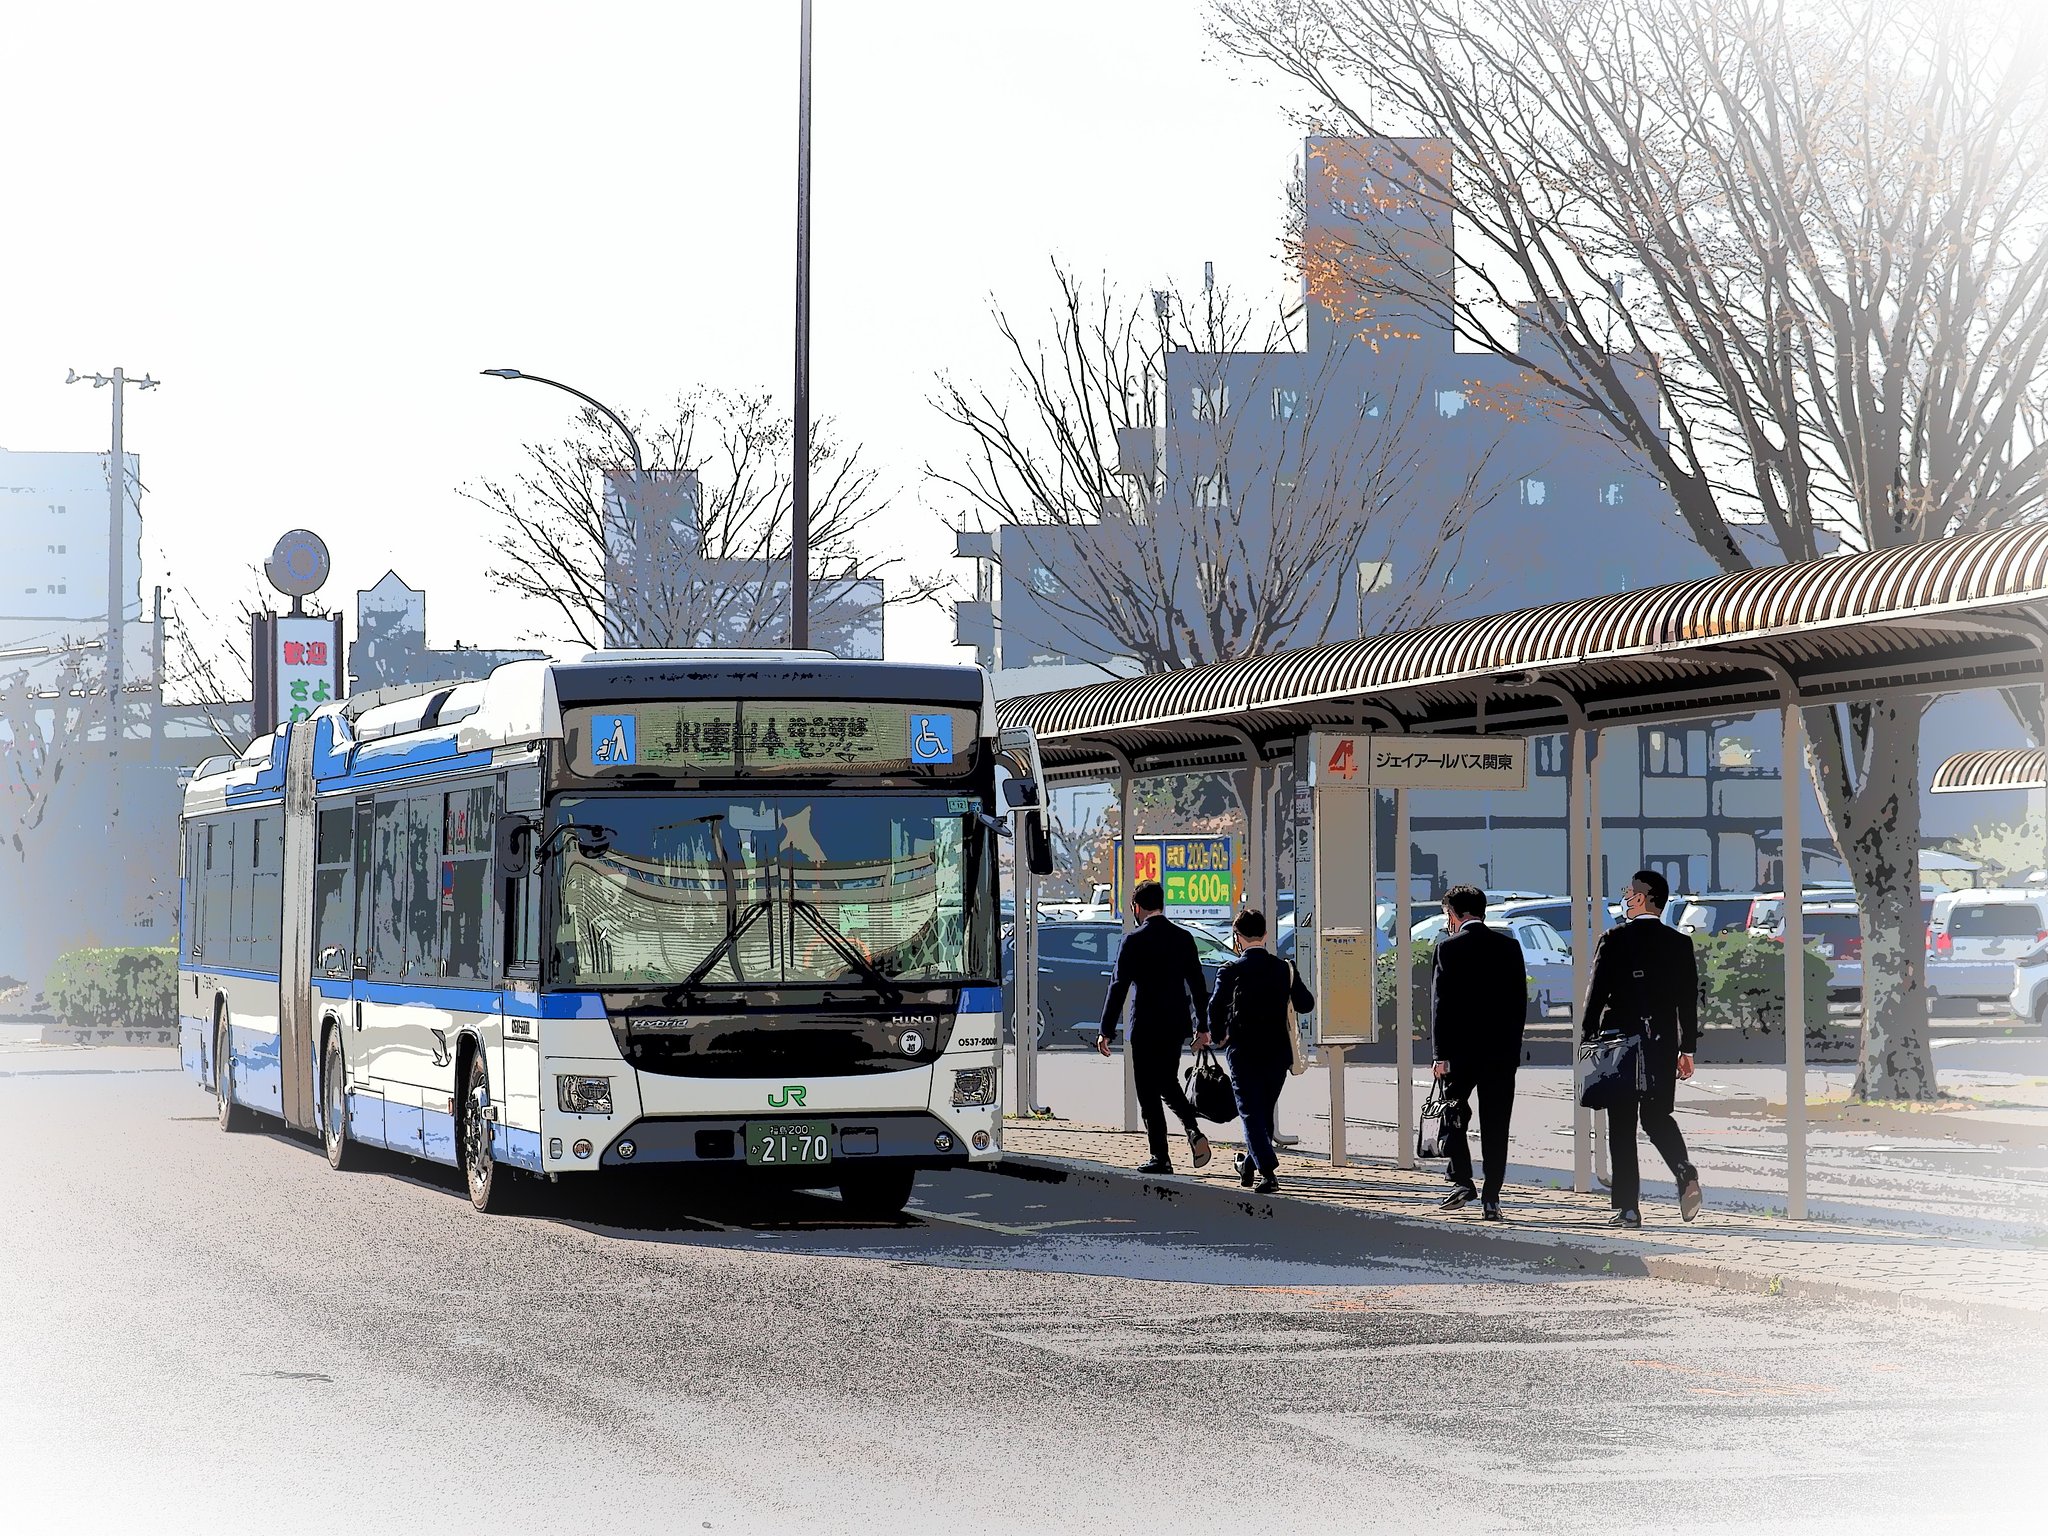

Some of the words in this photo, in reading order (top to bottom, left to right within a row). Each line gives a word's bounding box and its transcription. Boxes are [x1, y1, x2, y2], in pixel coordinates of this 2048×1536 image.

[284, 641, 328, 666] 歓迎
[1327, 739, 1358, 780] 4
[1376, 753, 1513, 771] ジェイアールバス関東
[1134, 852, 1157, 880] PC
[1188, 874, 1230, 902] 600円
[631, 1018, 690, 1028] Hybrid
[892, 1014, 935, 1024] HINO
[767, 1085, 807, 1108] JR
[761, 1136, 828, 1162] 21-70
